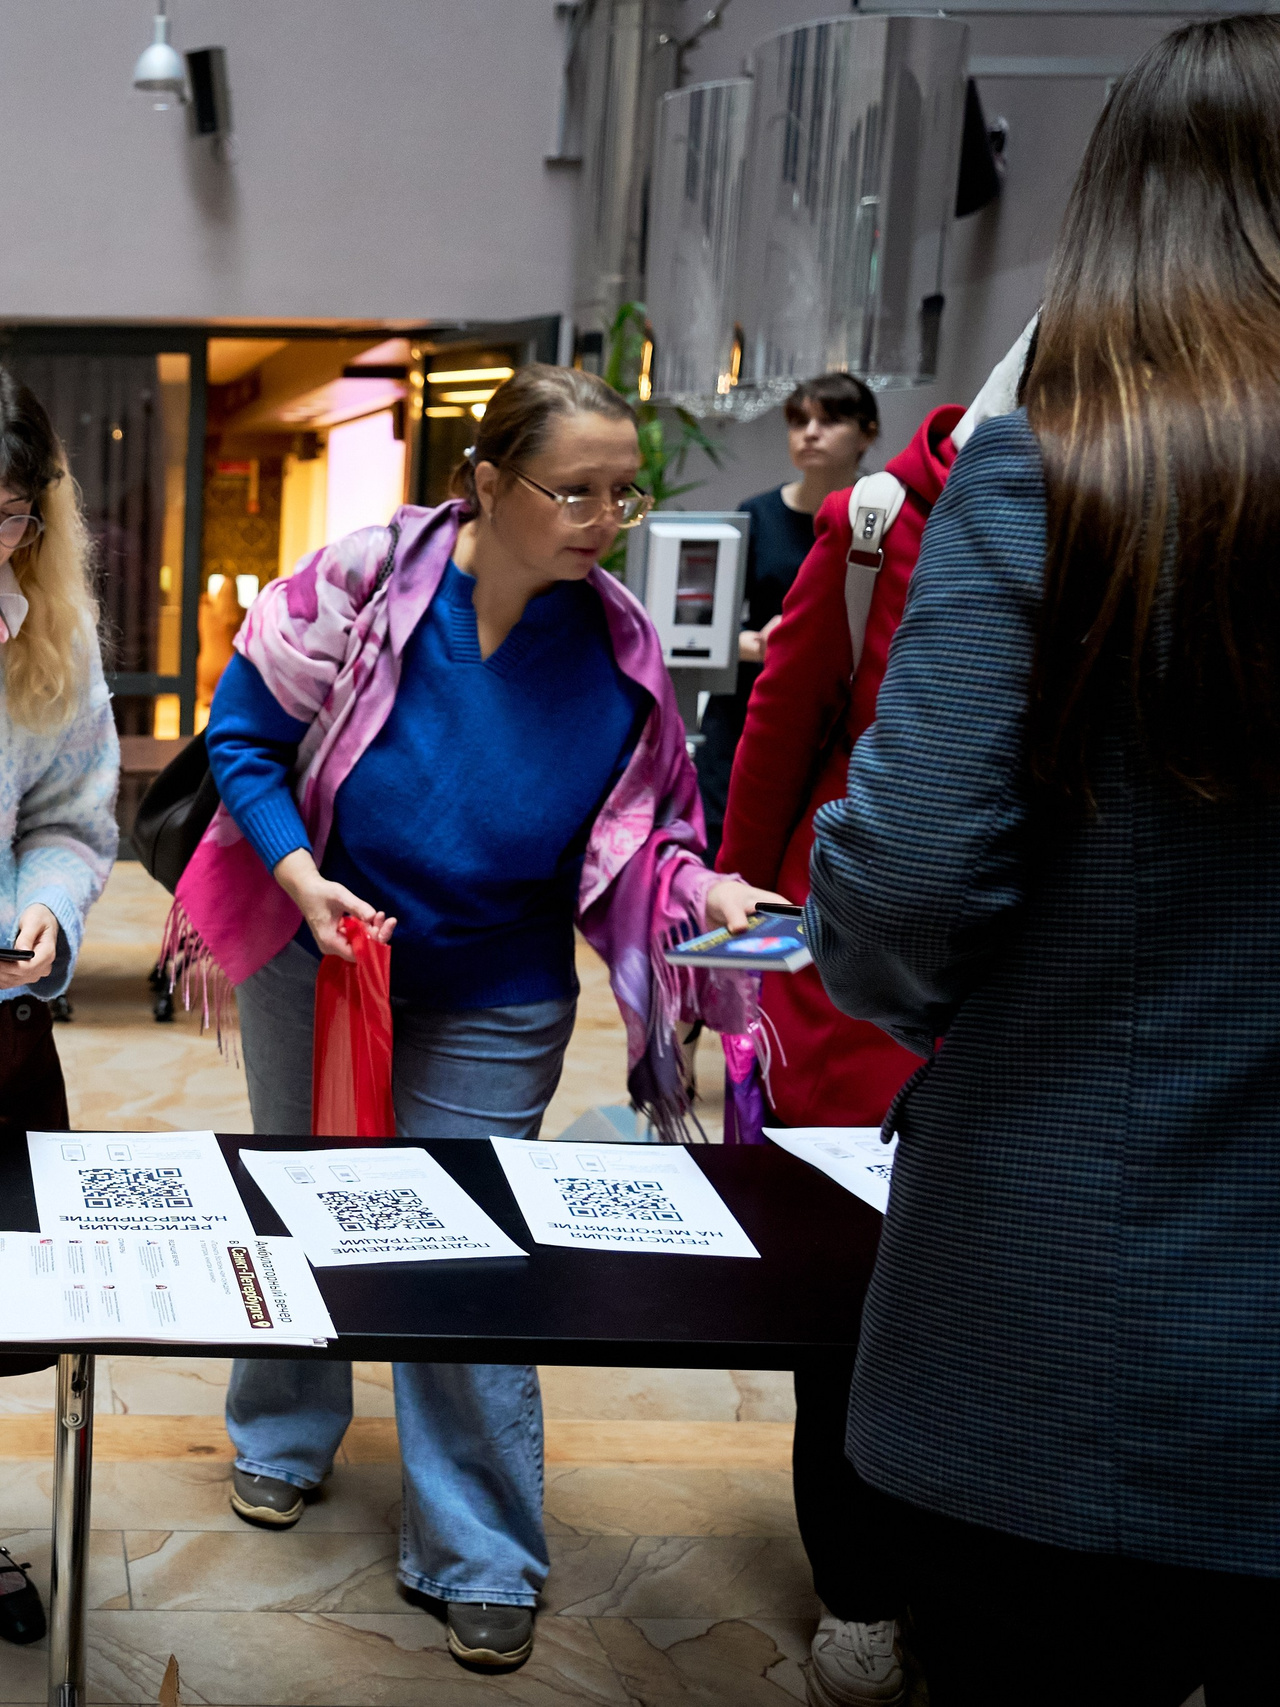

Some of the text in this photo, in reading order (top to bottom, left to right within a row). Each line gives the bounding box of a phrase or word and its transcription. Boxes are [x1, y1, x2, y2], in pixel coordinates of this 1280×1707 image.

[201, 1214, 228, 1222] НА
[78, 1223, 213, 1231] РЕГИСТРАЦИЯ
[547, 1221, 724, 1238] НА МЕРОПРИЯТИЕ
[339, 1235, 469, 1246] РЕГИСТРАЦИИ
[570, 1232, 710, 1245] РЕГИСТРАЦИЯ
[331, 1242, 491, 1255] ПОДТВЕРЖДЕНИЕ
[230, 1247, 265, 1320] Санкт-Петербурге
[253, 1240, 293, 1323] Амбулаторный вечер
